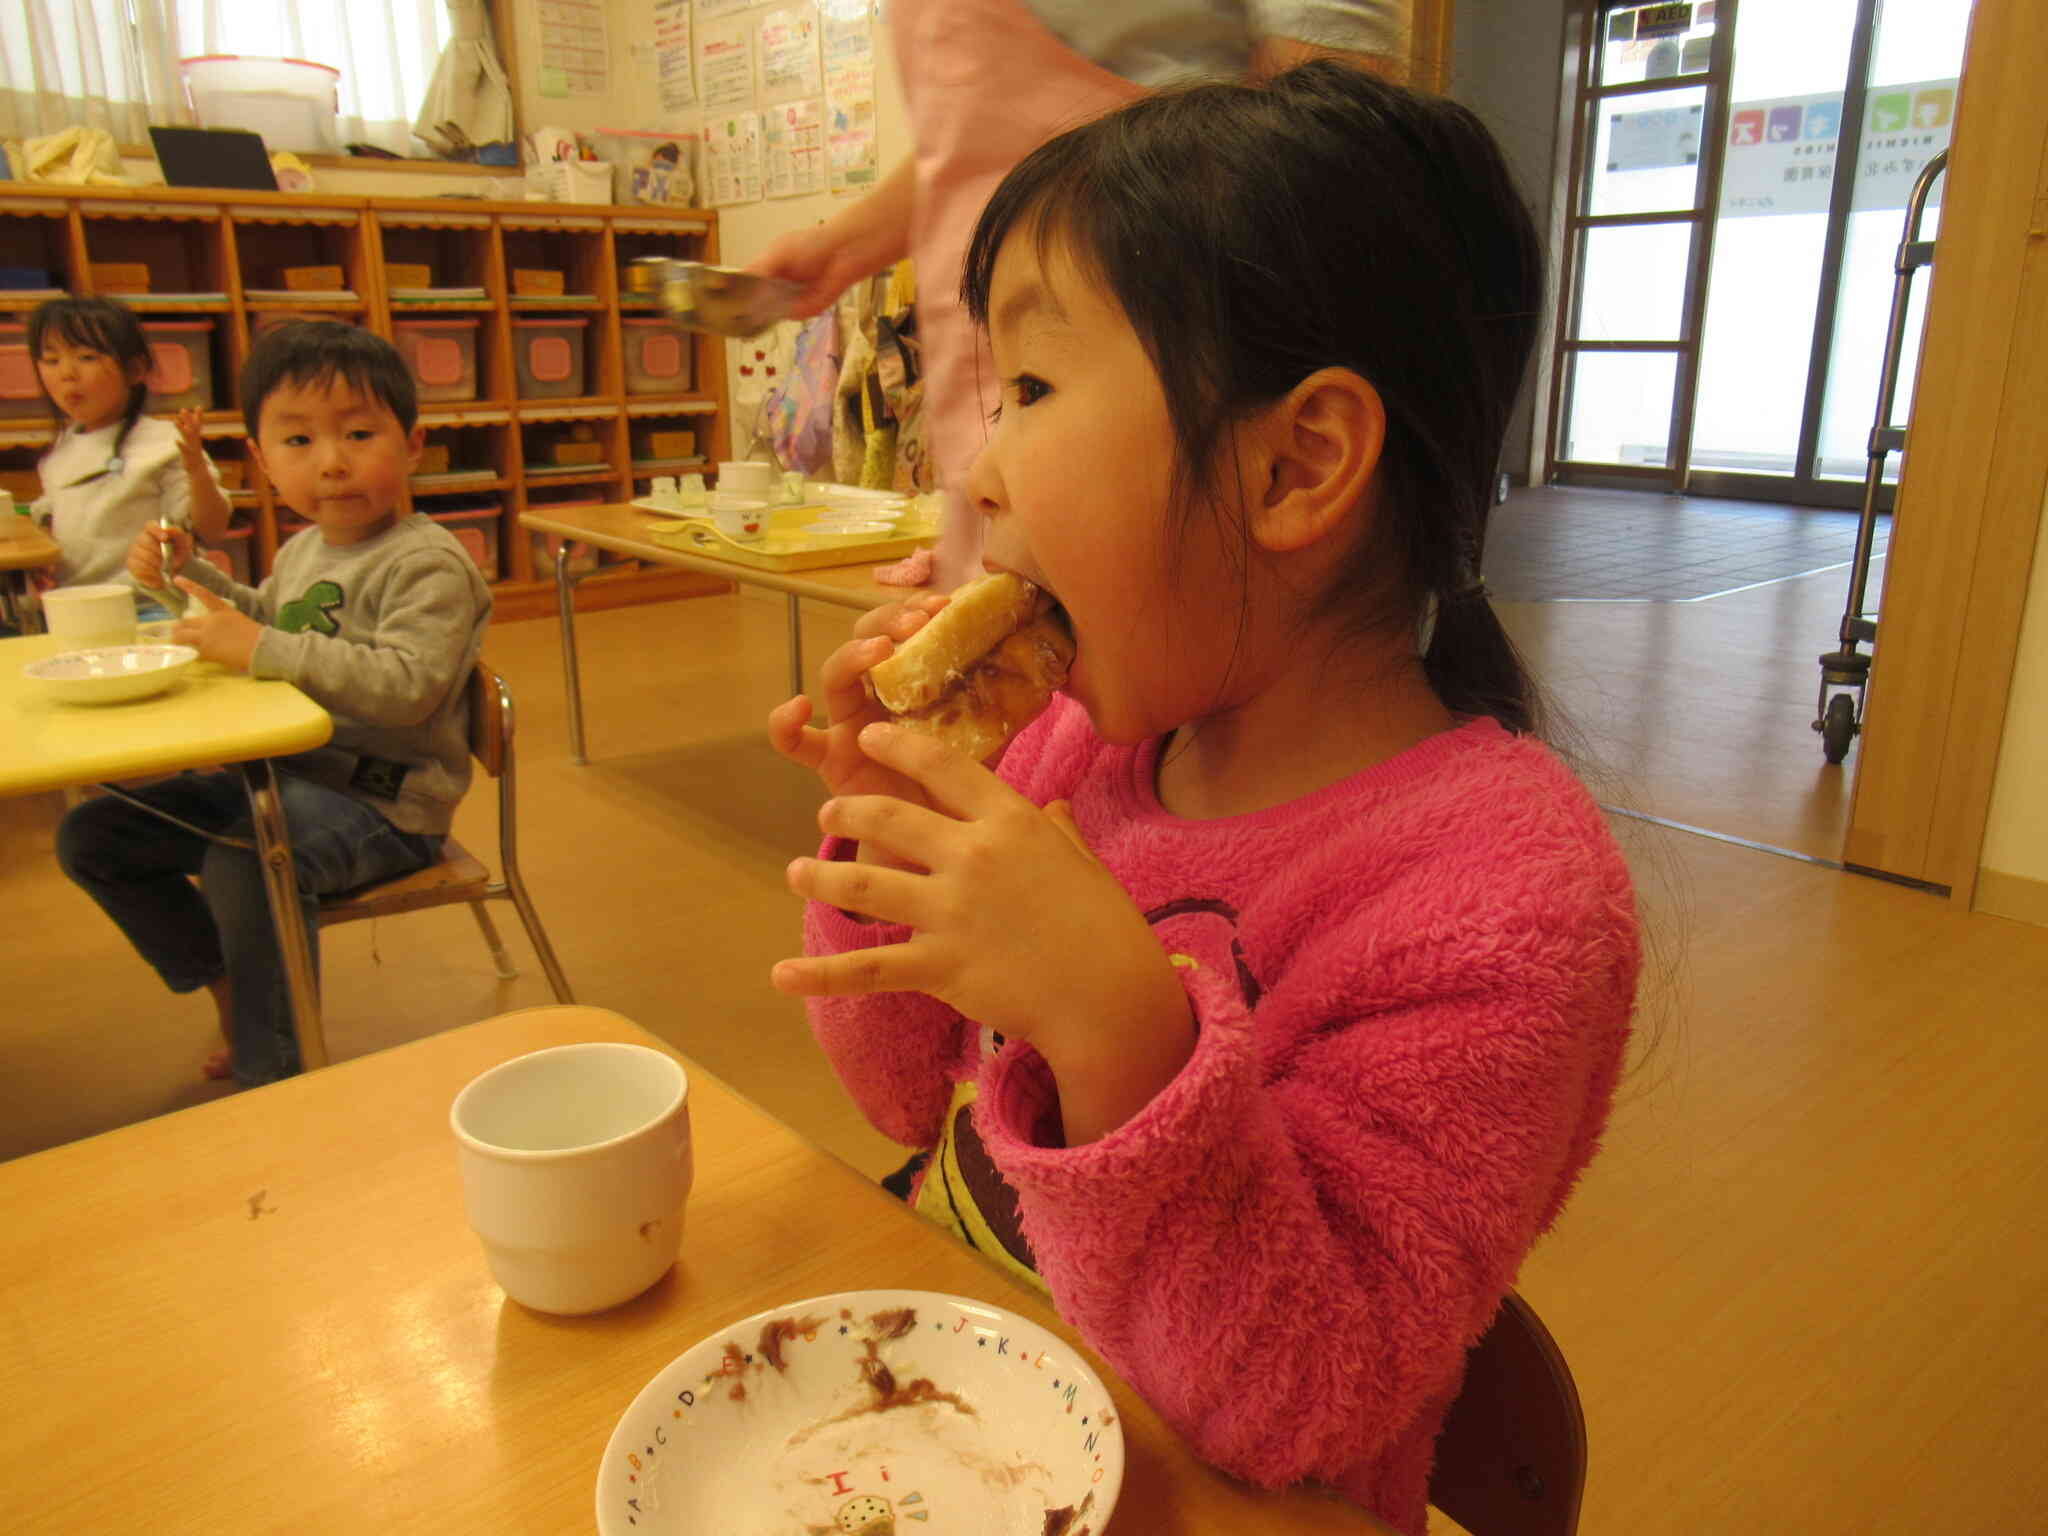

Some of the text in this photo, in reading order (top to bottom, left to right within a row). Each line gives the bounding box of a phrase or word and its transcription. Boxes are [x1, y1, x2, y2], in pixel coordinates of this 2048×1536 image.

[1655, 4, 1690, 21] AED
[679, 1391, 693, 1405] D
[953, 1317, 968, 1333] J
[998, 1337, 1009, 1354] K
[1084, 1432, 1099, 1452] N
